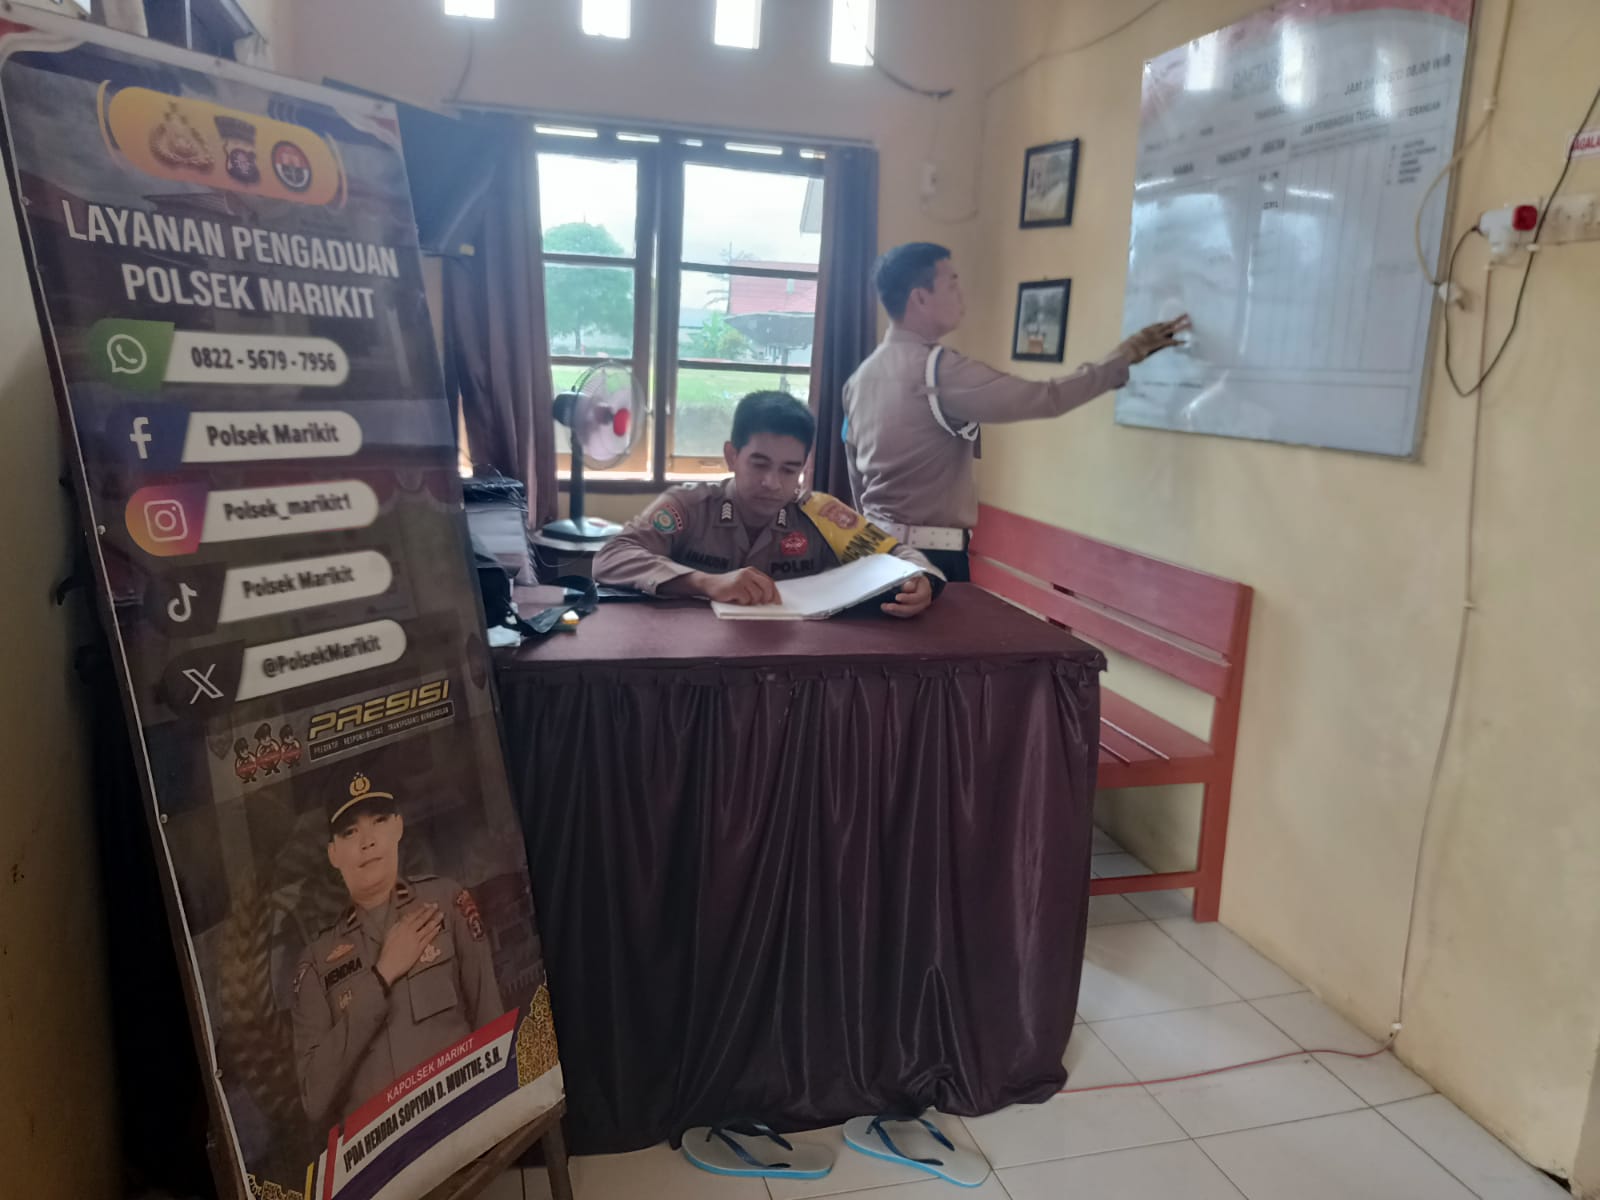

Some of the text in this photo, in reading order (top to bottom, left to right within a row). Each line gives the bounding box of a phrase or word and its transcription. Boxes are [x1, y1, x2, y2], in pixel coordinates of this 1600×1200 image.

[62, 200, 399, 278] LAYANAN PENGADUAN
[122, 263, 375, 319] POLSEK MARIKIT
[191, 346, 232, 370] 0822
[247, 350, 287, 371] 5679
[206, 423, 340, 447] Polsek Marikit
[242, 566, 354, 598] Polsek Marikit
[771, 560, 815, 573] POLRI
[261, 634, 382, 678] @PolsekMarikit
[308, 680, 449, 739] PRESISI
[386, 1038, 475, 1102] KAPOLSEK MARIKIT
[343, 1046, 503, 1173] IPDA HENDRA SOPIYAN D. MUNTHE, S.H.
